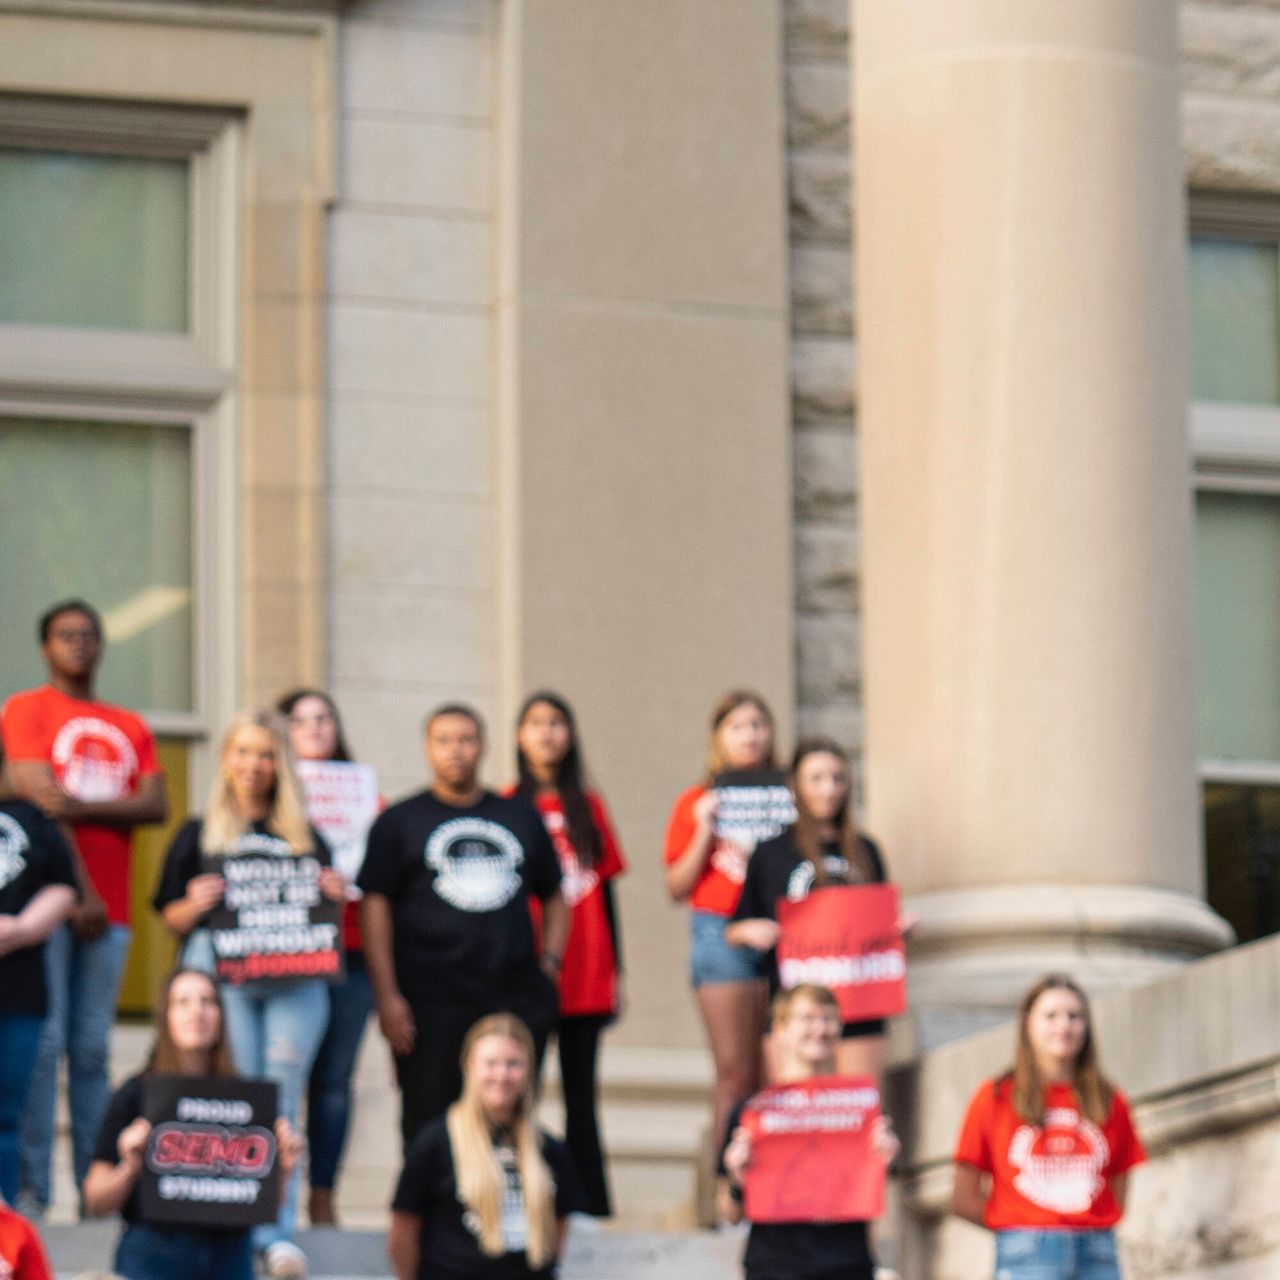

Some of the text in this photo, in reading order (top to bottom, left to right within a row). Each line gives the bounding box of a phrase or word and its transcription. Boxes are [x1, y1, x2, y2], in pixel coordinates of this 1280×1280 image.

[225, 859, 319, 881] WOULD
[215, 925, 337, 956] WITHOUT
[178, 1098, 252, 1124] PROUD
[153, 1131, 269, 1171] SEMO
[159, 1175, 261, 1203] STUDENT
